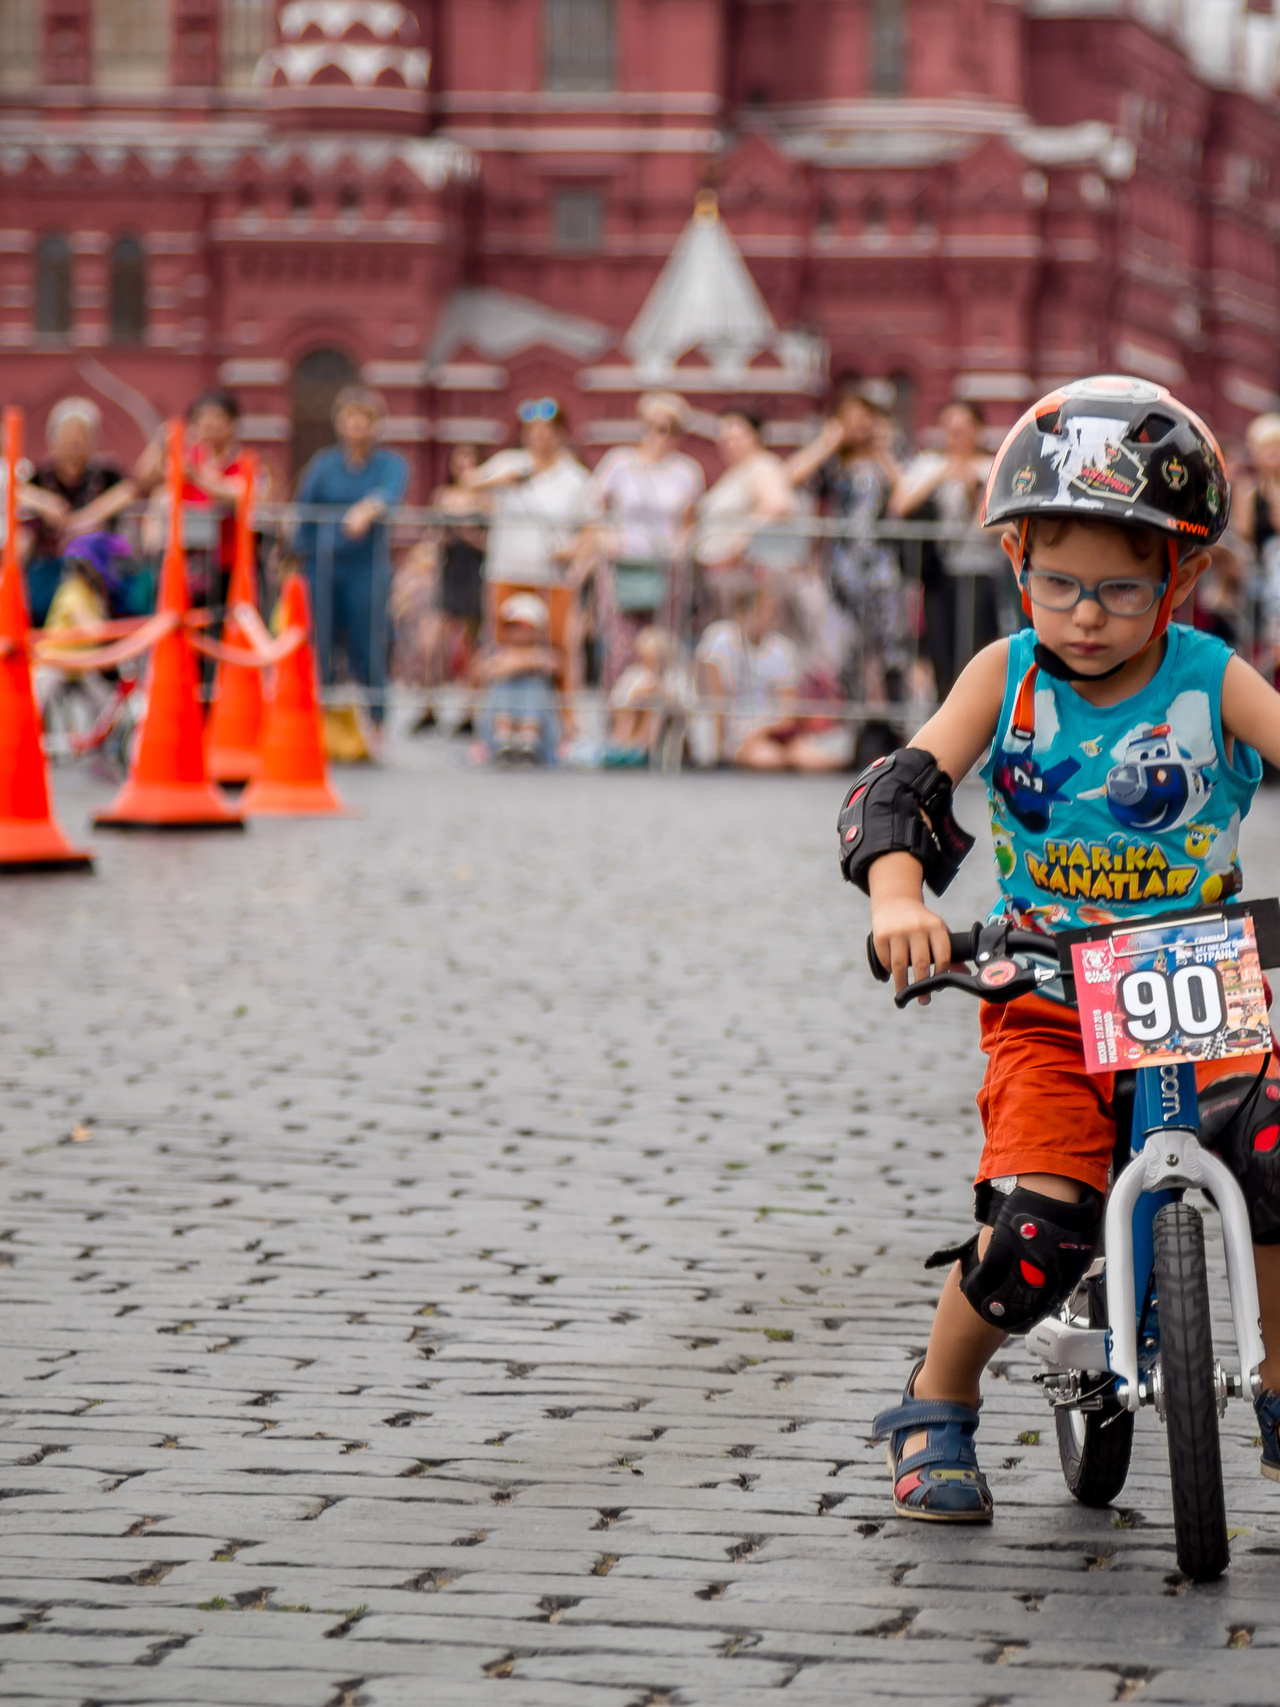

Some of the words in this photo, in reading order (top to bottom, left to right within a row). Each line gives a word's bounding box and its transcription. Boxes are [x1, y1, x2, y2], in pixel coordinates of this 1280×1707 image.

[1027, 854, 1198, 900] KANATLAR
[1195, 948, 1239, 963] СТРАНЫ
[1122, 965, 1222, 1041] 90
[1160, 1064, 1180, 1122] oom
